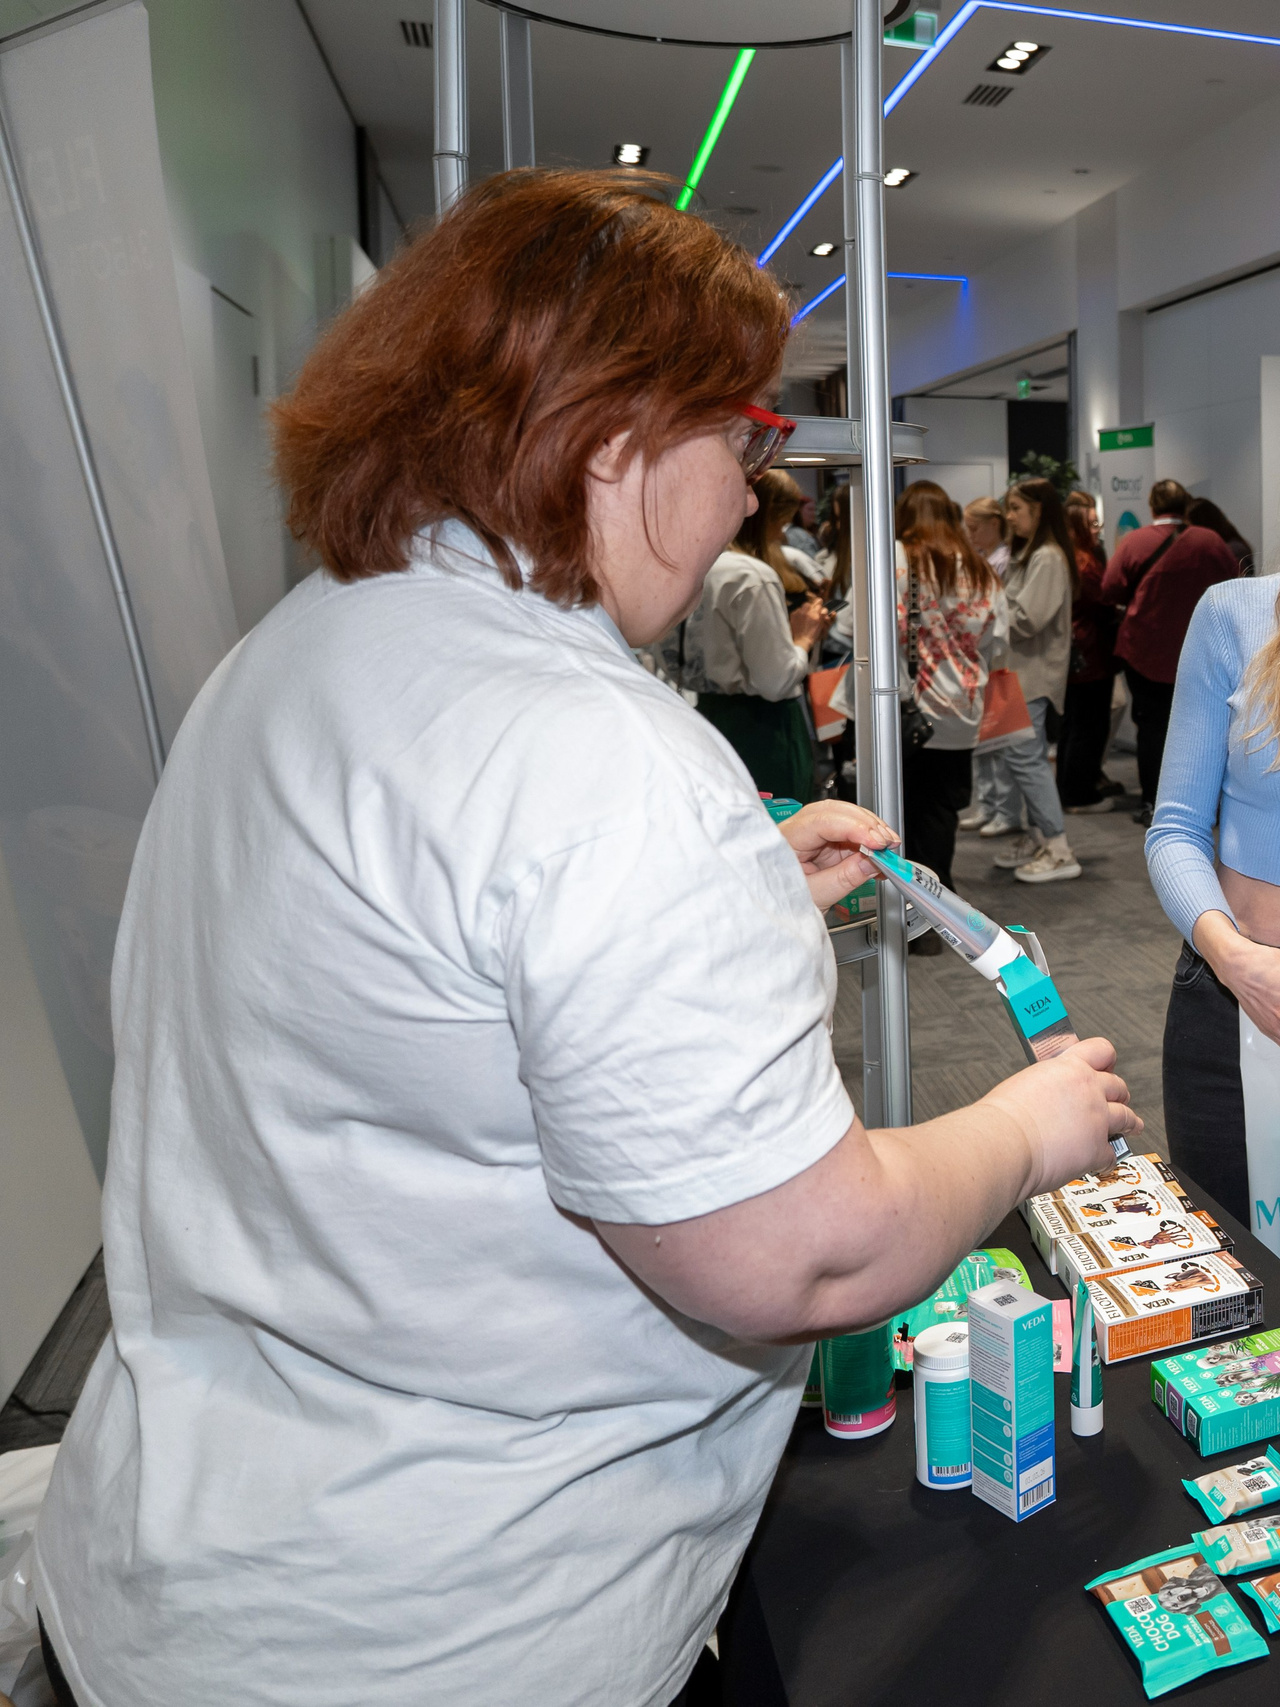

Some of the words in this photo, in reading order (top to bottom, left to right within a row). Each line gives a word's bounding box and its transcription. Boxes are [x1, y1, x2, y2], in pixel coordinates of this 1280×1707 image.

[1024, 996, 1052, 1015] VEDA
[1071, 1187, 1099, 1196] VEDA
[1039, 1201, 1066, 1236] БИОРИТМ
[1087, 1218, 1117, 1228] VEDA
[1064, 1235, 1097, 1272] БИОРИТМ
[1118, 1252, 1149, 1264] VEDA
[1143, 1297, 1175, 1310] VEDA
[1022, 1314, 1046, 1331] VEDA
[1164, 1359, 1181, 1375] VEDA
[1180, 1376, 1197, 1394] VEDA
[1199, 1395, 1217, 1413] VEDA
[1137, 1613, 1170, 1652] CHOCO
[1156, 1613, 1181, 1640] DOG
[1124, 1625, 1145, 1648] VEDA
